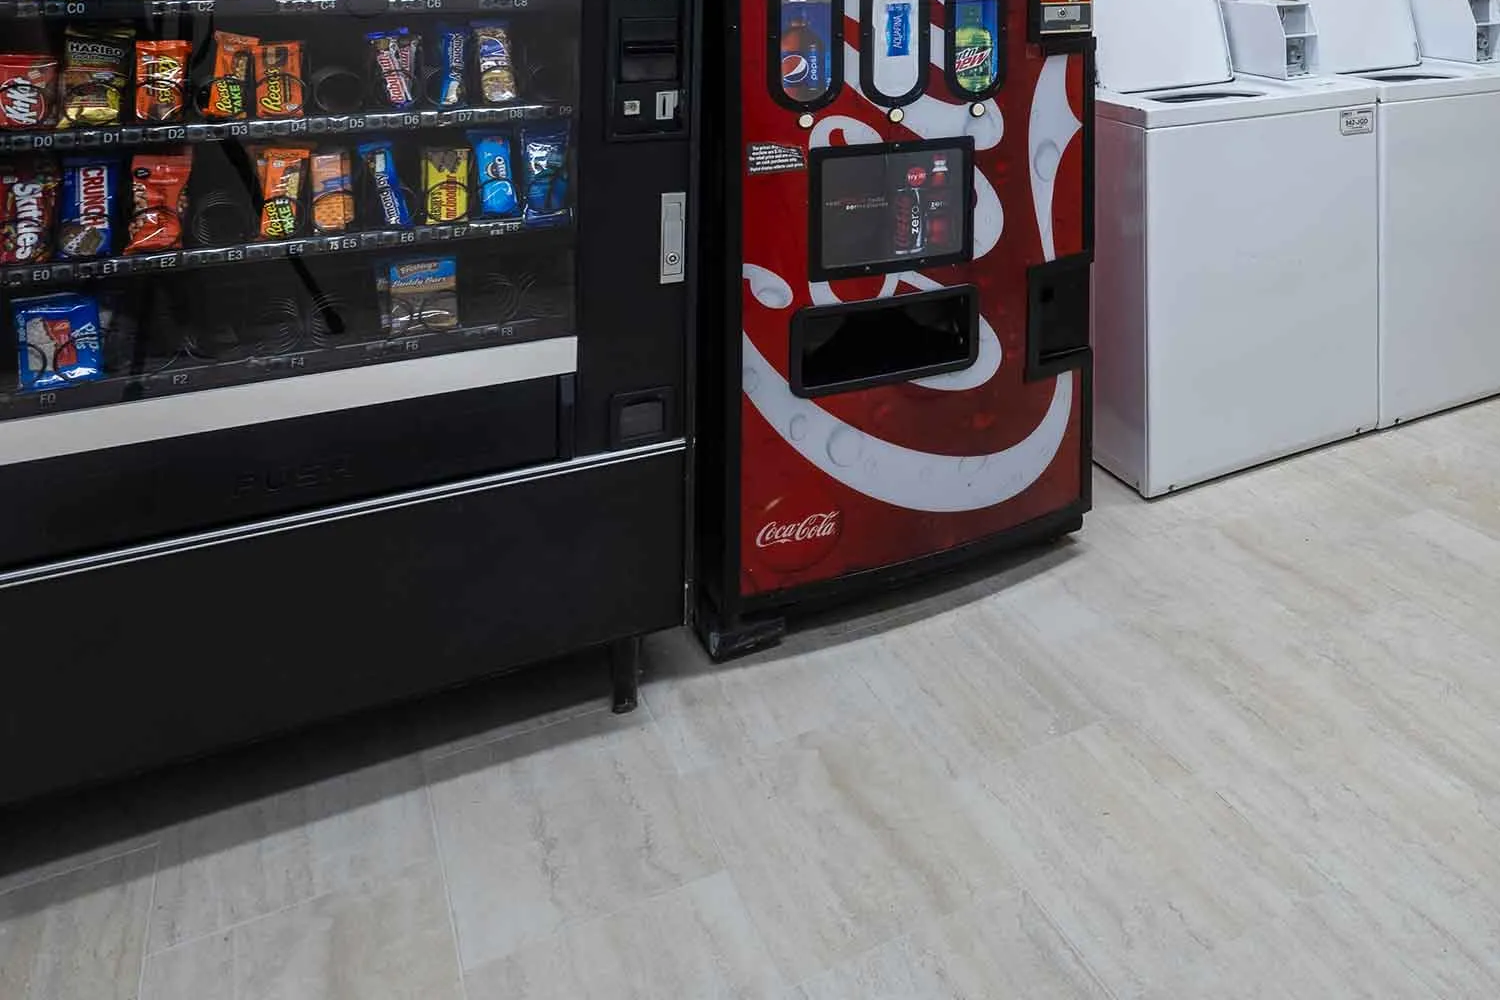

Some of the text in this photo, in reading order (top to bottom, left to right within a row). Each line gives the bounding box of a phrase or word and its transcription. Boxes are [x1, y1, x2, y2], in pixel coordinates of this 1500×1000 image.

[67, 2, 85, 14] C0
[68, 41, 125, 59] HARIBO
[33, 136, 53, 147] D0
[103, 132, 120, 143] D1
[168, 128, 185, 139] D2
[231, 125, 248, 135] D3
[350, 118, 365, 128] D5
[404, 115, 419, 125] D6
[911, 204, 921, 235] zero
[33, 270, 50, 281] E0
[160, 257, 177, 268] E2
[228, 250, 243, 261] E3
[343, 239, 357, 249] E5
[401, 233, 414, 243] E6
